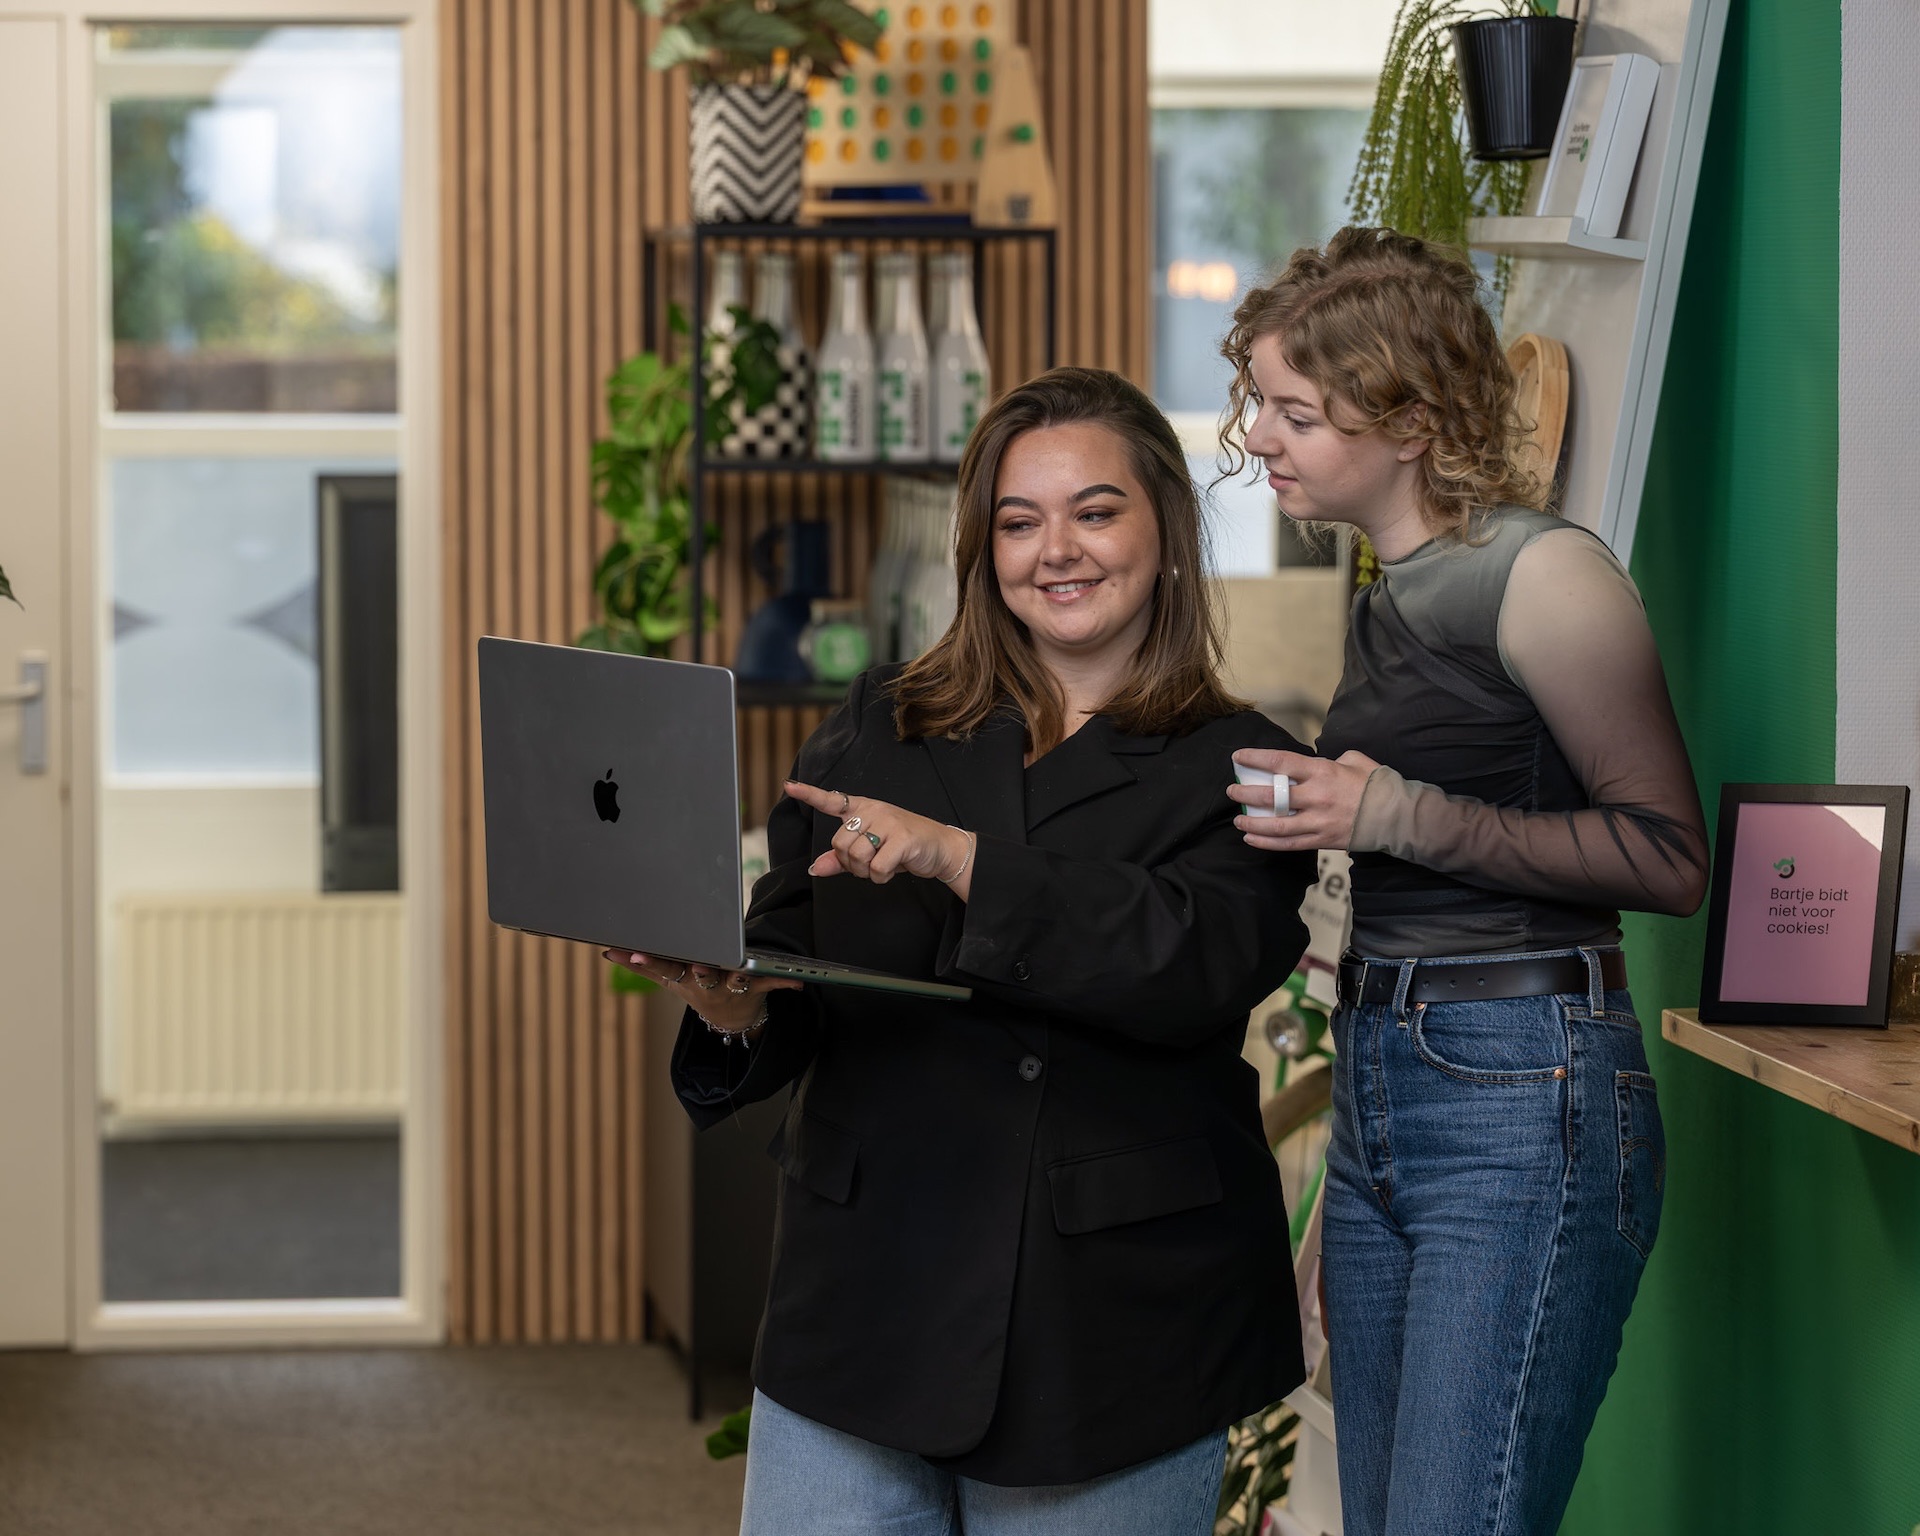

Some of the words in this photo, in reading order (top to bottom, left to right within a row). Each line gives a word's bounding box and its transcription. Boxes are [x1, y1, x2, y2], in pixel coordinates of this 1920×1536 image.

[1770, 888, 1814, 904] Bartje
[1819, 888, 1849, 901] bidt
[1768, 904, 1797, 917] niet
[1801, 907, 1836, 918] voor
[1767, 921, 1829, 935] cookies!
